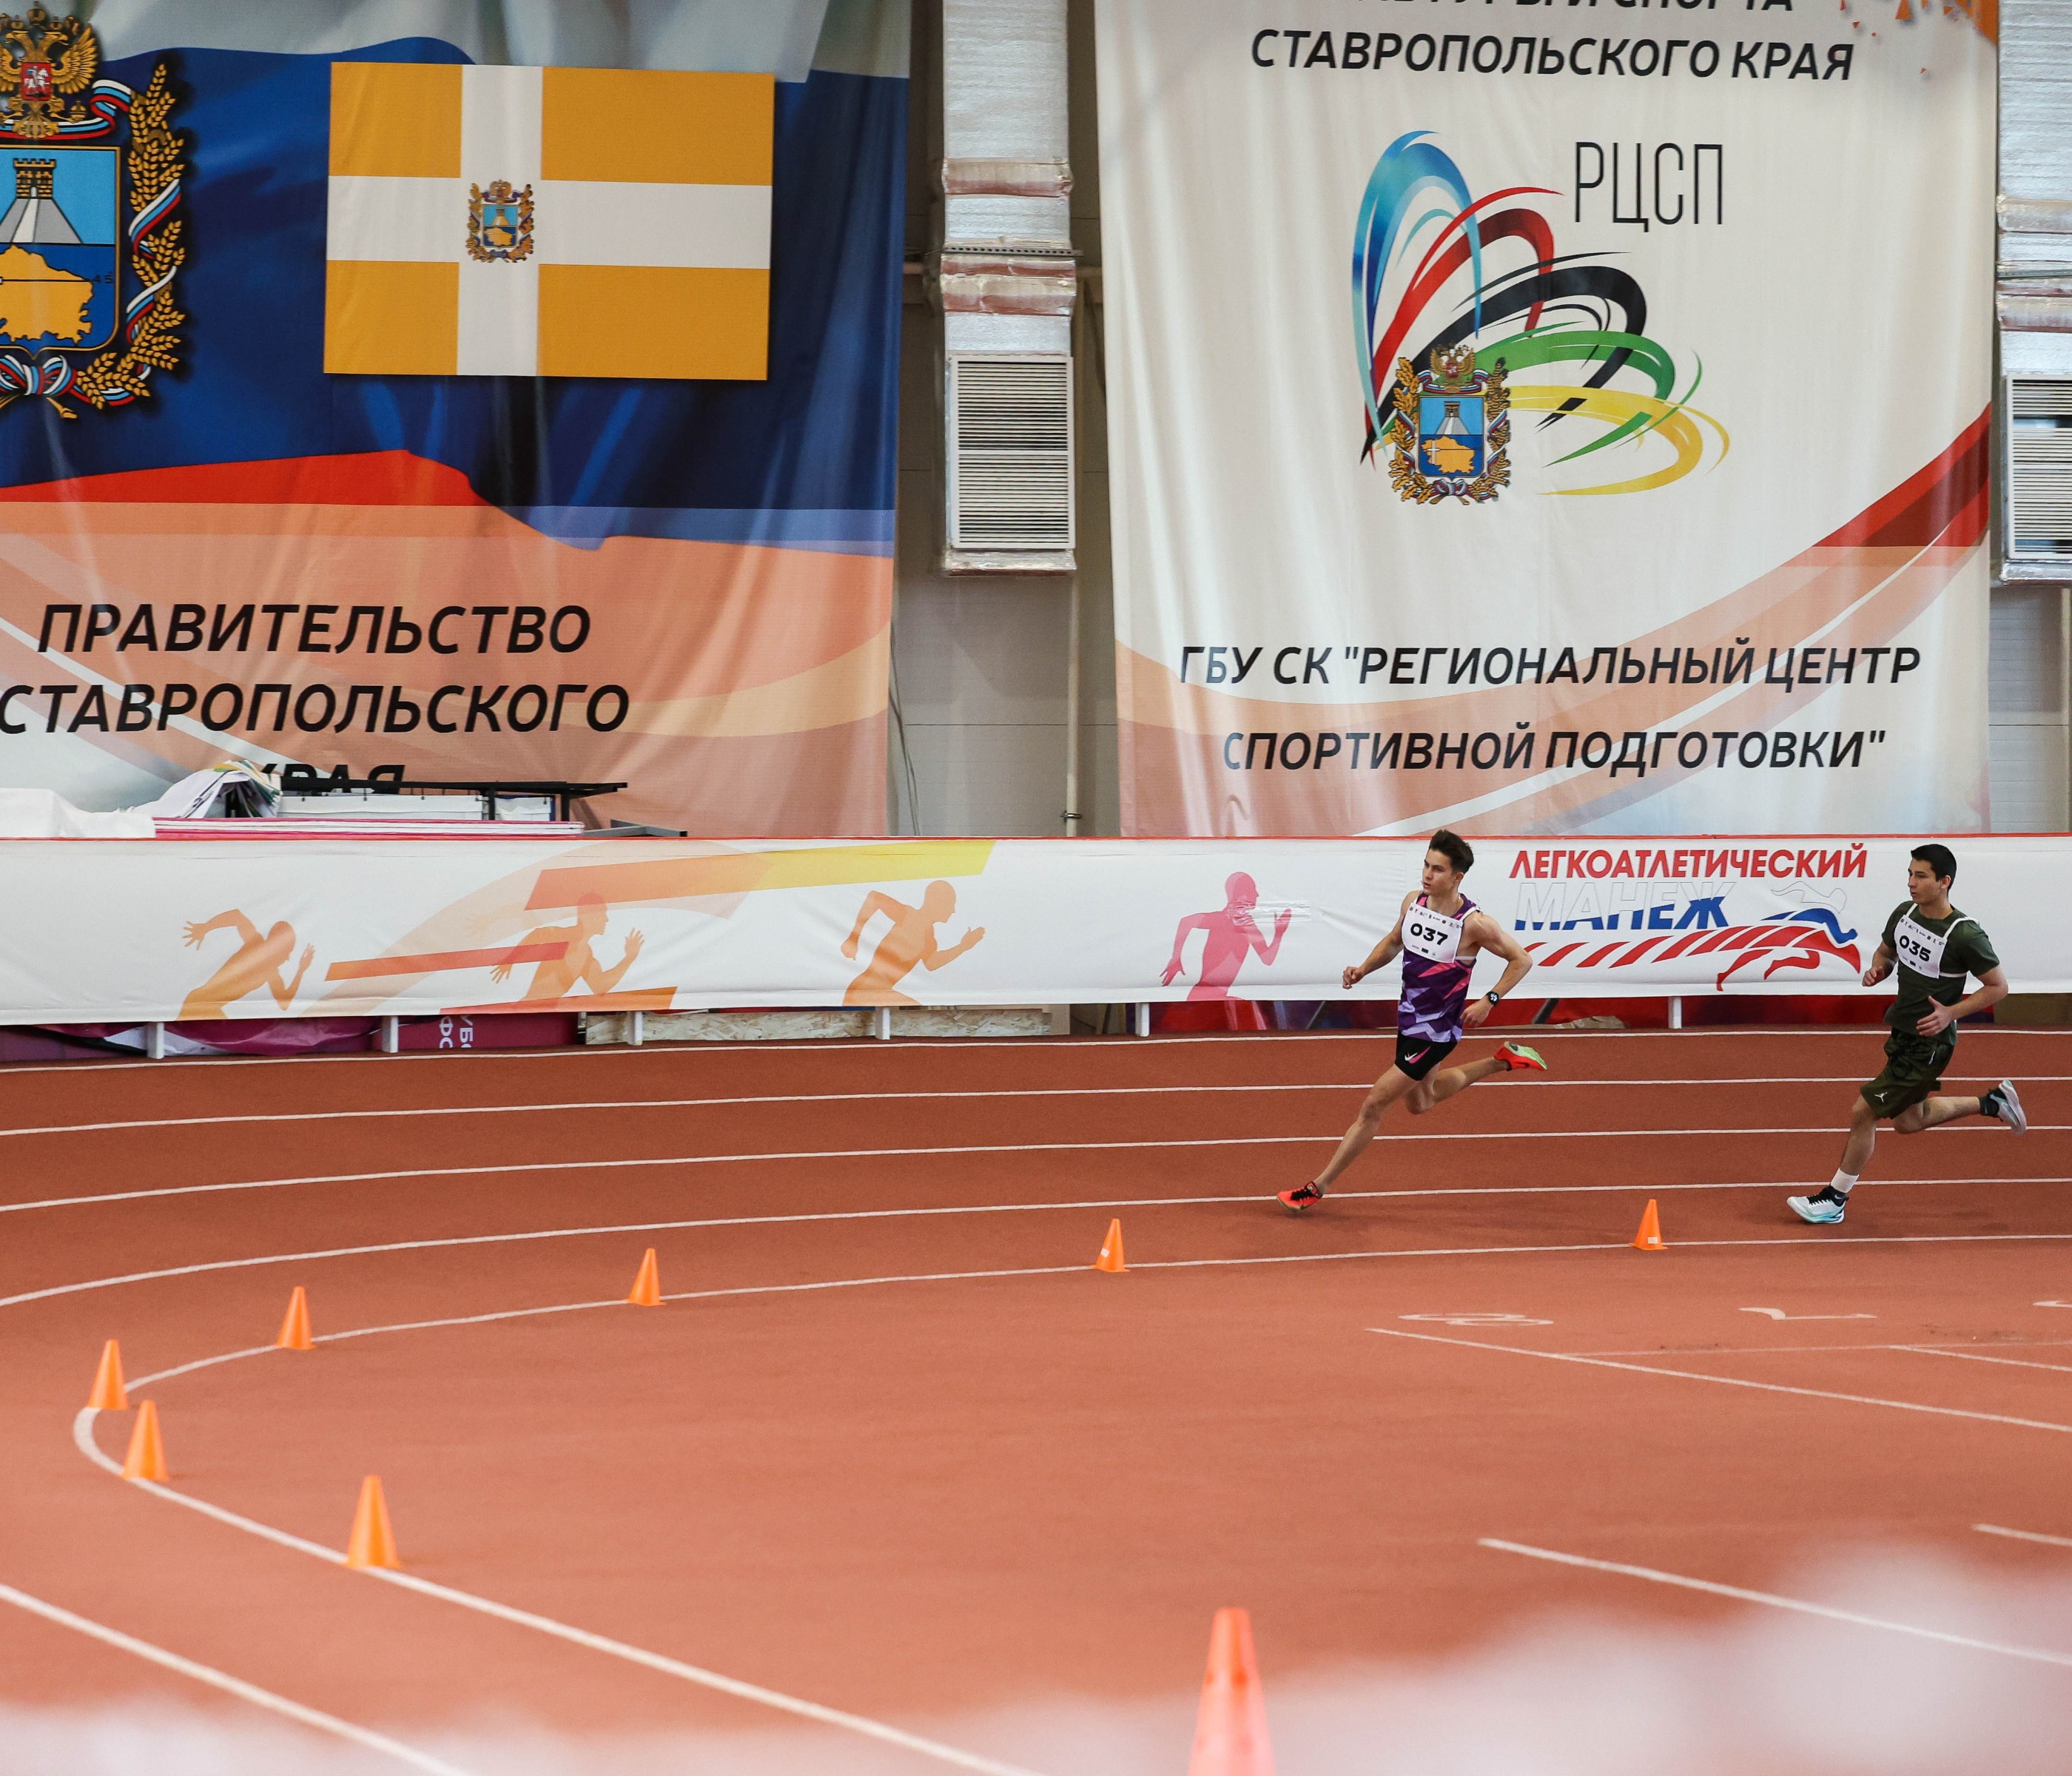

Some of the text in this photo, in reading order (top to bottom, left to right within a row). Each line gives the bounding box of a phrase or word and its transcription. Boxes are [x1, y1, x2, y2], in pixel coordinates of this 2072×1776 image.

[1251, 29, 1854, 81] СТАВРОПОЛЬСКОГО КРАЯ
[1575, 141, 1723, 233] РЦСП
[38, 603, 591, 654] ПРАВИТЕЛЬСТВО
[1180, 637, 1920, 693] ГБУ СК "РЕГИОНАЛЬНЫЙ ЦЕНТР
[0, 682, 629, 735] СТАВРОПОЛЬСКОГО
[1224, 722, 1886, 778] СПОРТИВНОЙ ПОДГОТОВКИ"
[1510, 843, 1867, 878] ЛЕГКОАТЛЕТИЧЕСКИЙ
[1515, 882, 1736, 930] МАНЕЖ
[1410, 923, 1448, 946] 037
[1899, 935, 1931, 962] 035
